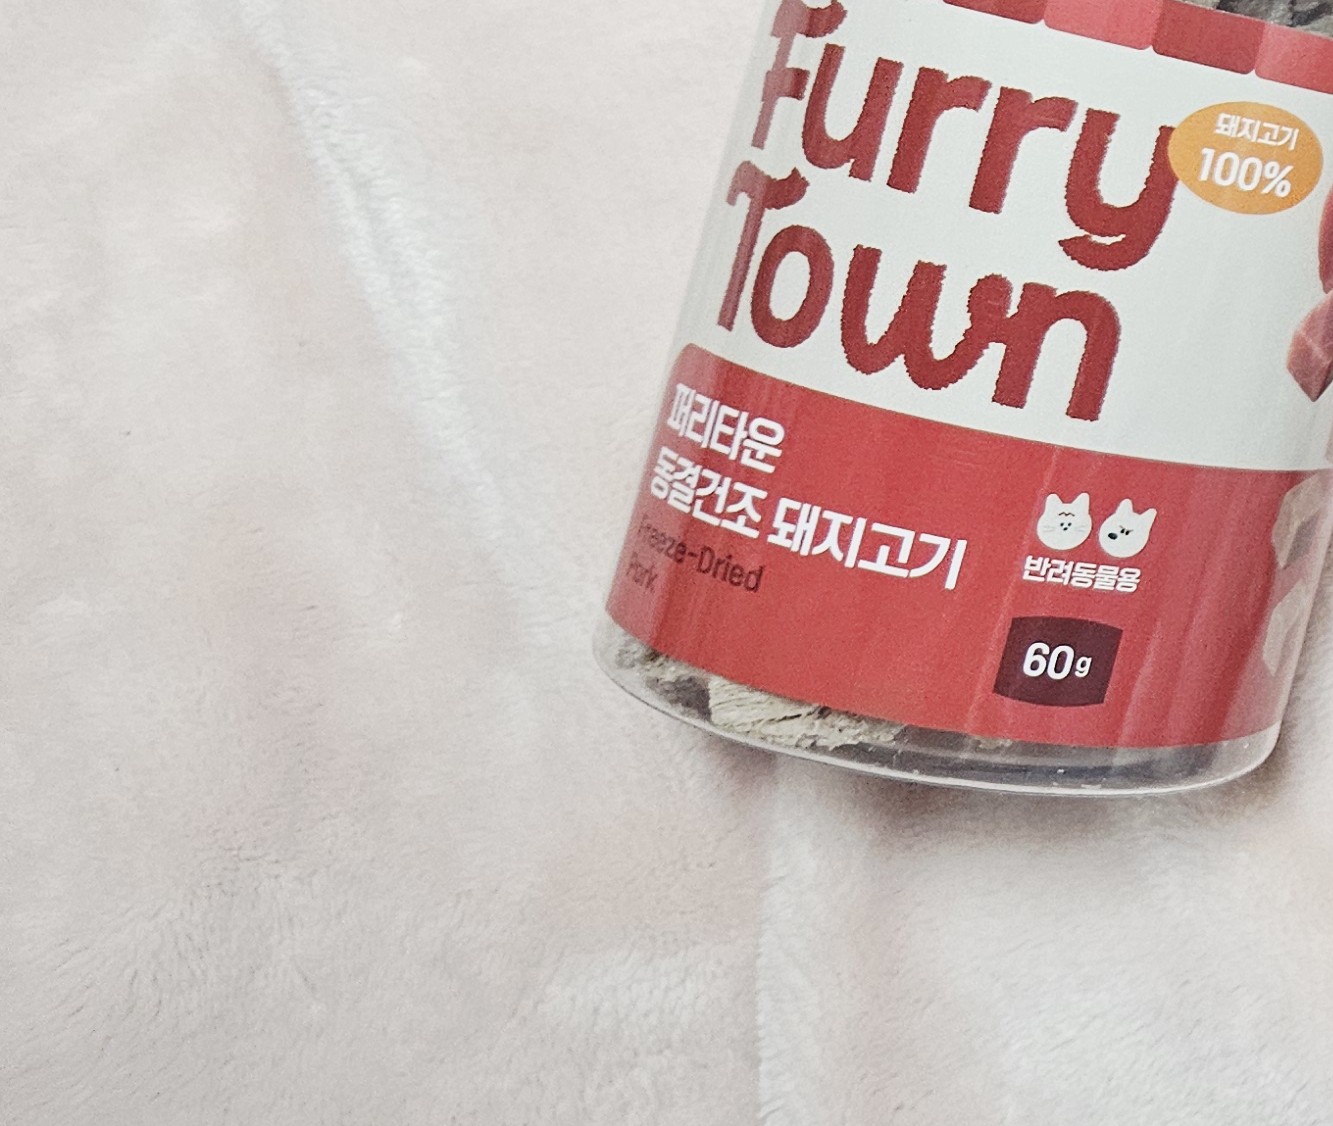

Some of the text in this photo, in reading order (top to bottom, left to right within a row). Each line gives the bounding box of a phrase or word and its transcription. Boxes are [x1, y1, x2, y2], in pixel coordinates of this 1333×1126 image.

[1214, 112, 1300, 151] 돼지고기
[1199, 147, 1294, 198] 100%
[716, 160, 1122, 423] Town
[667, 382, 785, 473] 퍼리타운
[651, 446, 967, 591] 동결건조 돼지고기
[637, 514, 766, 593] Freeze-Dried
[1022, 554, 1142, 593] 반려동물용
[1021, 641, 1093, 682] 60g
